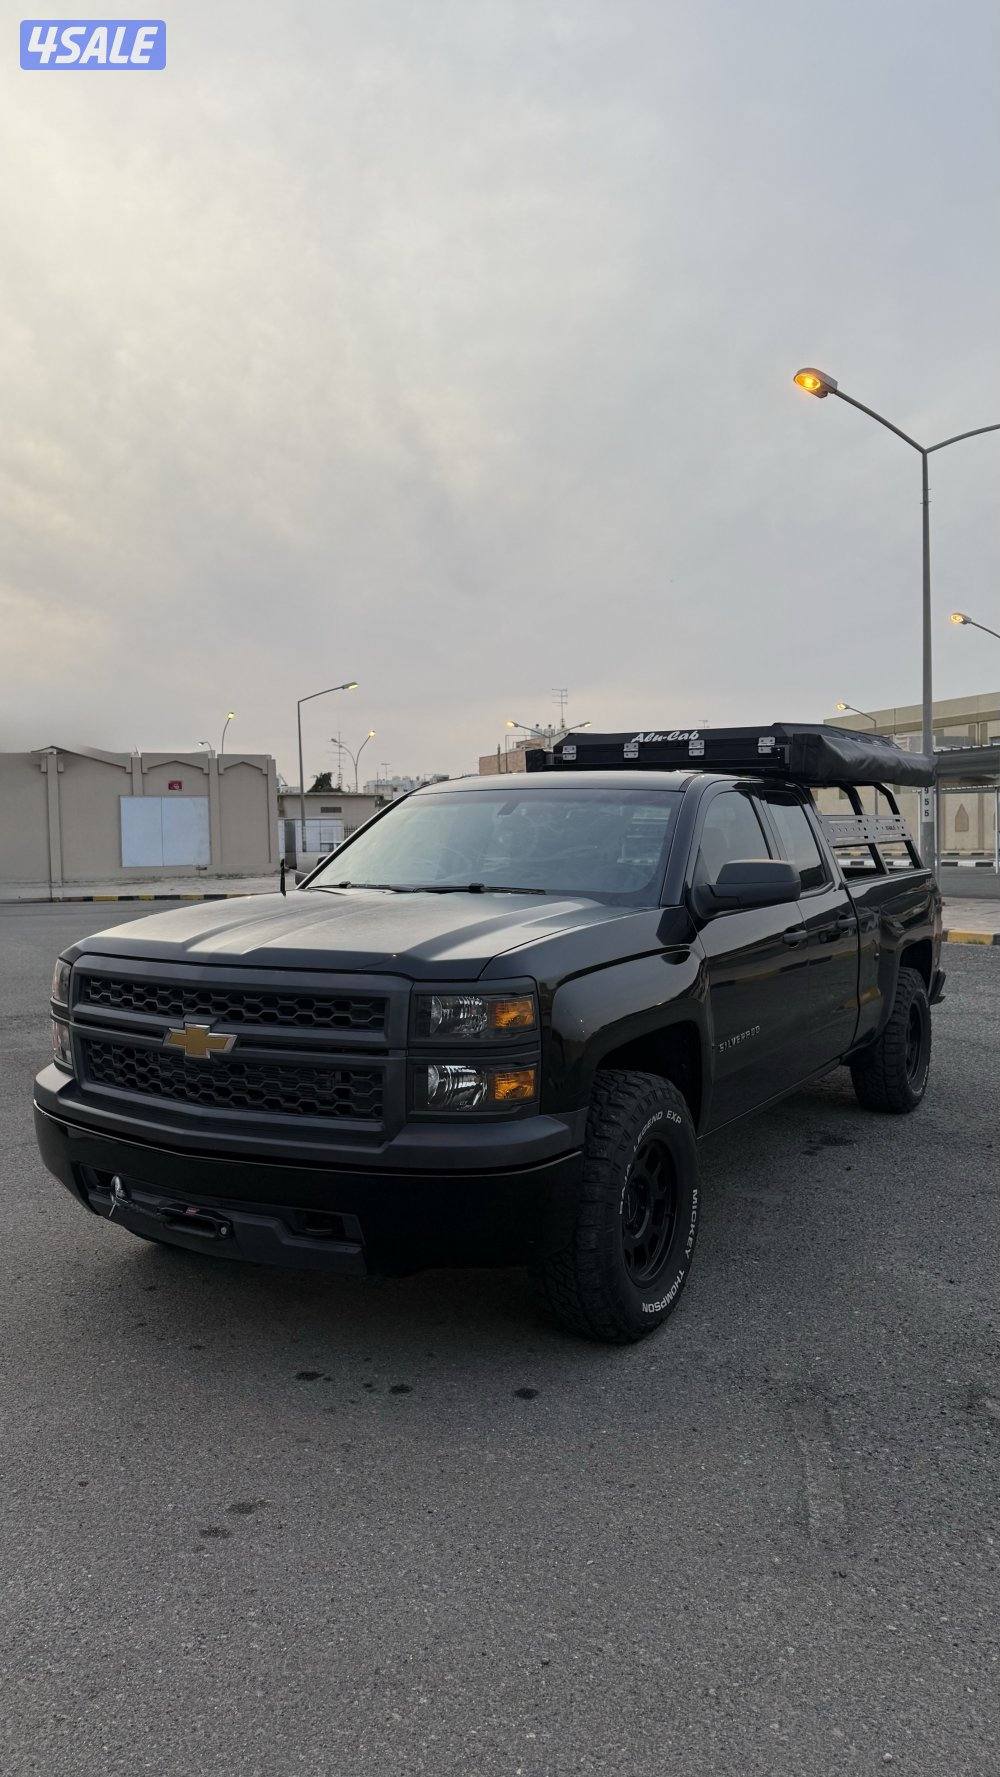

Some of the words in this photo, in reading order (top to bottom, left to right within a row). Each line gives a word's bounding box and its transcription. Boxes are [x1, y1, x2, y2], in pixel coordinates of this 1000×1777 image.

[630, 730, 700, 743] Alu-Cab
[633, 1110, 663, 1152] LEGEND
[666, 1109, 682, 1124] EXP
[685, 1189, 698, 1259] MICKEY
[642, 1269, 685, 1313] THOMPSON
